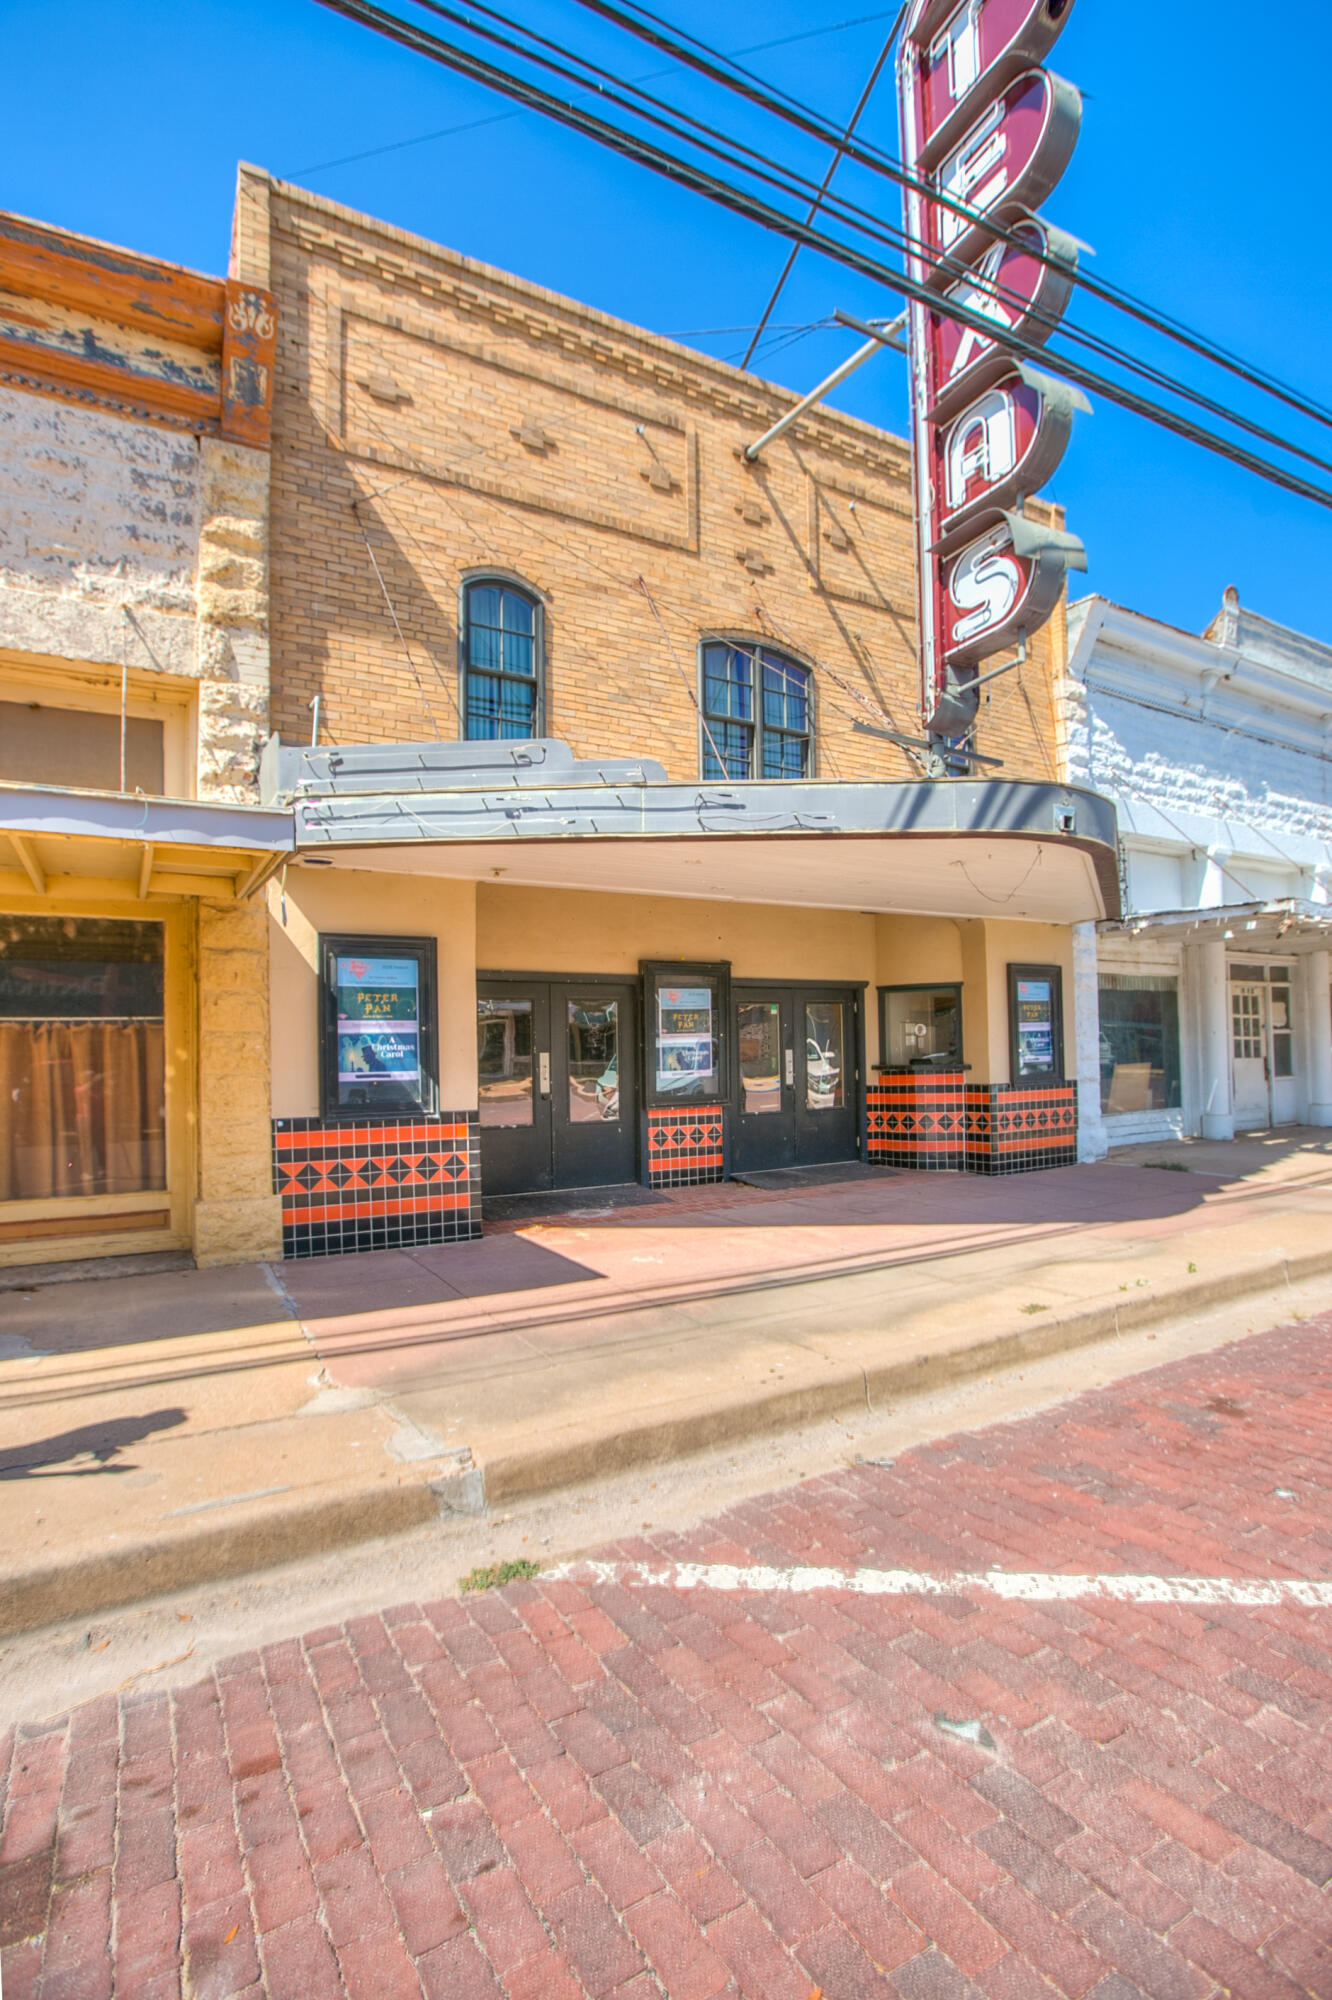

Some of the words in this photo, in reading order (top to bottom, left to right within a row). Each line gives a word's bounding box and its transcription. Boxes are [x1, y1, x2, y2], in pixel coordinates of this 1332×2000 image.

[929, 0, 1017, 644] TEXAS
[357, 992, 398, 1003] PETER
[365, 1003, 391, 1015] PAN
[389, 1036, 396, 1044] A
[372, 1043, 415, 1051] Christmas
[380, 1050, 404, 1058] Carol
